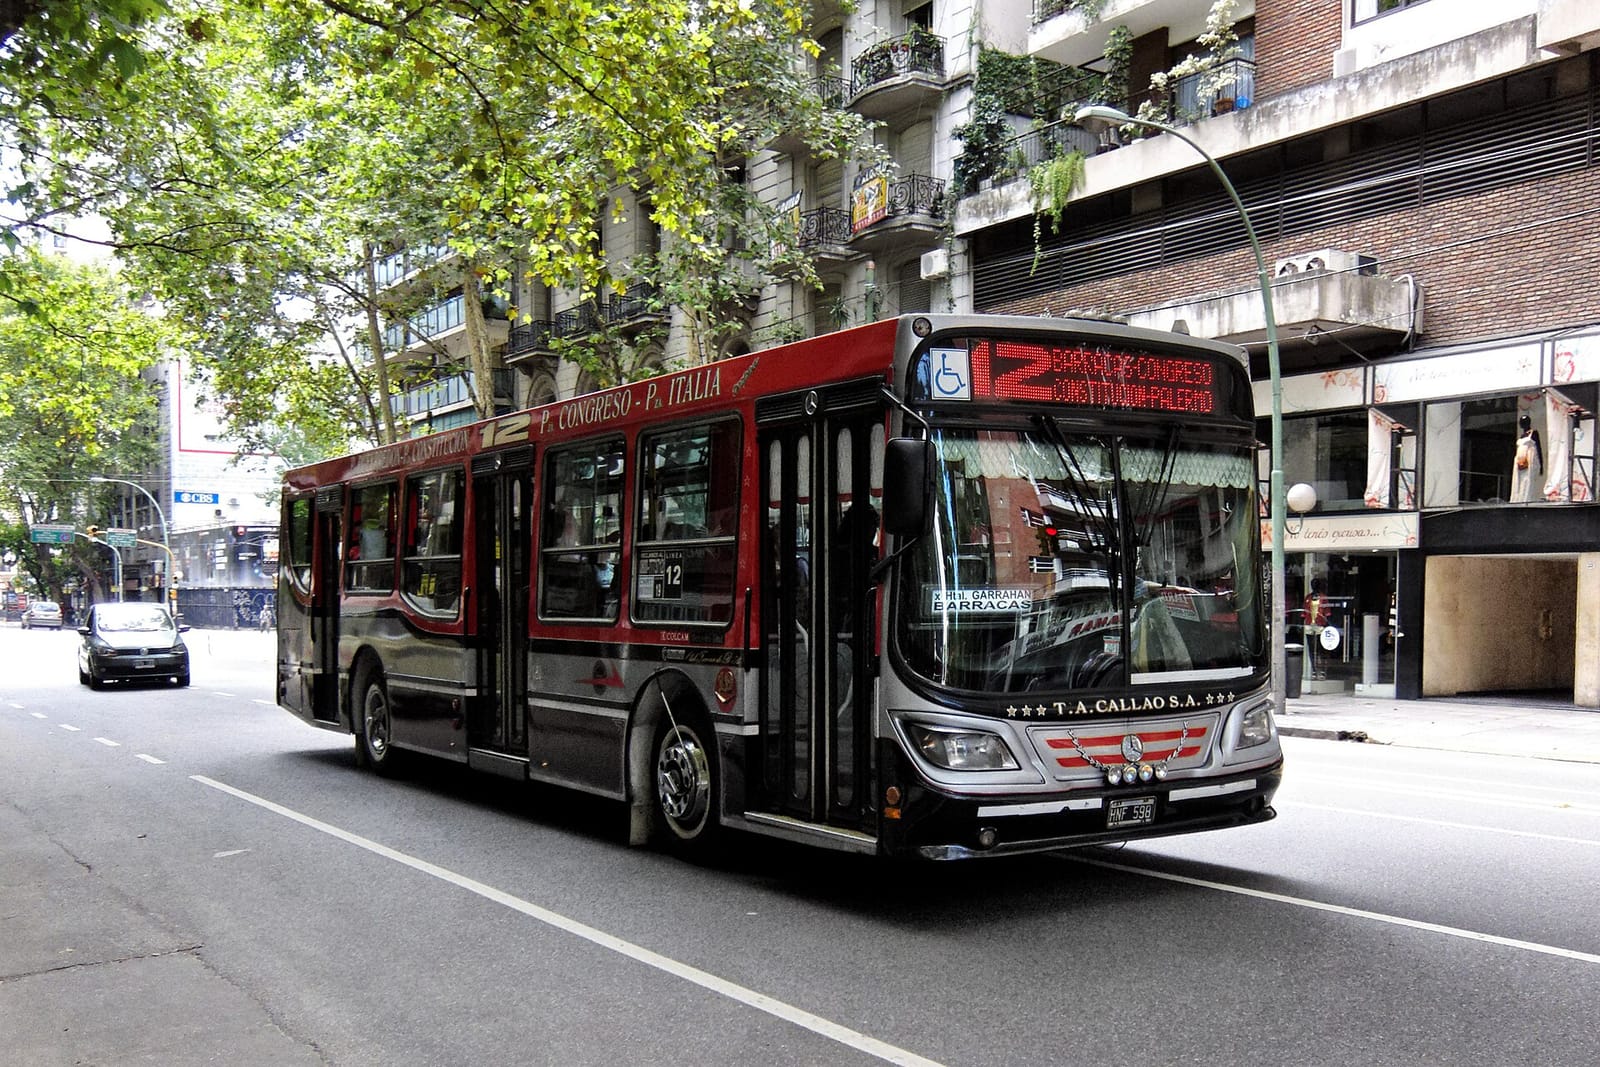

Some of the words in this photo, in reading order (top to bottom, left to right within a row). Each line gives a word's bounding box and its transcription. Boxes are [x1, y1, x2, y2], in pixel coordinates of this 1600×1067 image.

[971, 341, 1053, 400] 12
[559, 389, 632, 430] CONGRESO
[668, 367, 721, 406] ITALIA
[479, 413, 531, 449] 12
[192, 493, 213, 503] CBS
[666, 564, 681, 585] 12
[972, 590, 1031, 601] GARRAHAN
[934, 600, 1031, 611] BARRACAS
[1169, 693, 1201, 708] S.A.
[1110, 806, 1129, 821] HNF
[1132, 805, 1152, 819] 598
